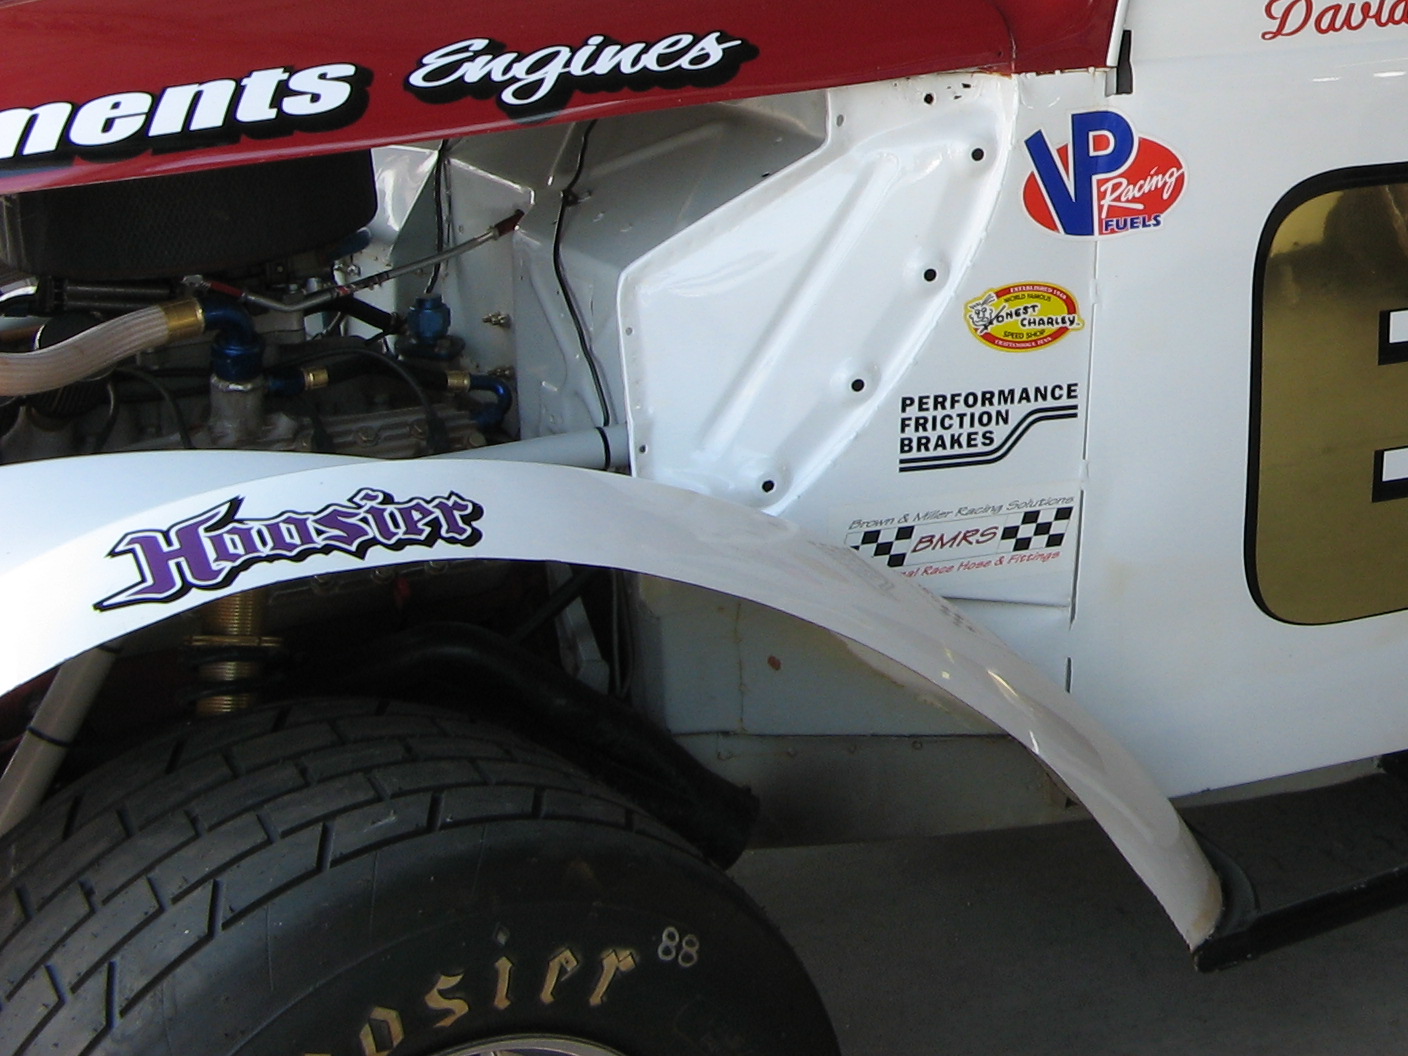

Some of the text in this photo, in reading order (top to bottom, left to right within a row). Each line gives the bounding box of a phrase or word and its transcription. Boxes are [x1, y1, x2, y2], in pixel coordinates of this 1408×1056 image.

[408, 30, 742, 105] Engines
[1024, 111, 1135, 237] VP
[1101, 167, 1185, 218] Racing
[1102, 214, 1162, 234] FUELS
[1003, 329, 1046, 340] SPEED SHOP
[1020, 315, 1076, 327] CHARLEY
[900, 383, 1079, 414] PERFORMANCE
[900, 410, 1010, 434] FRICTION
[899, 430, 995, 455] BRAKES
[848, 496, 1075, 530] Brown & Miller Racing Solutions
[93, 488, 485, 611] Hoosier
[910, 526, 1000, 554] BMRS
[920, 564, 954, 577] Race
[957, 559, 992, 572] Hose
[993, 555, 1005, 567] &
[1007, 550, 1062, 566] Fittings
[656, 925, 700, 968] 88
[304, 947, 638, 1056] osier
